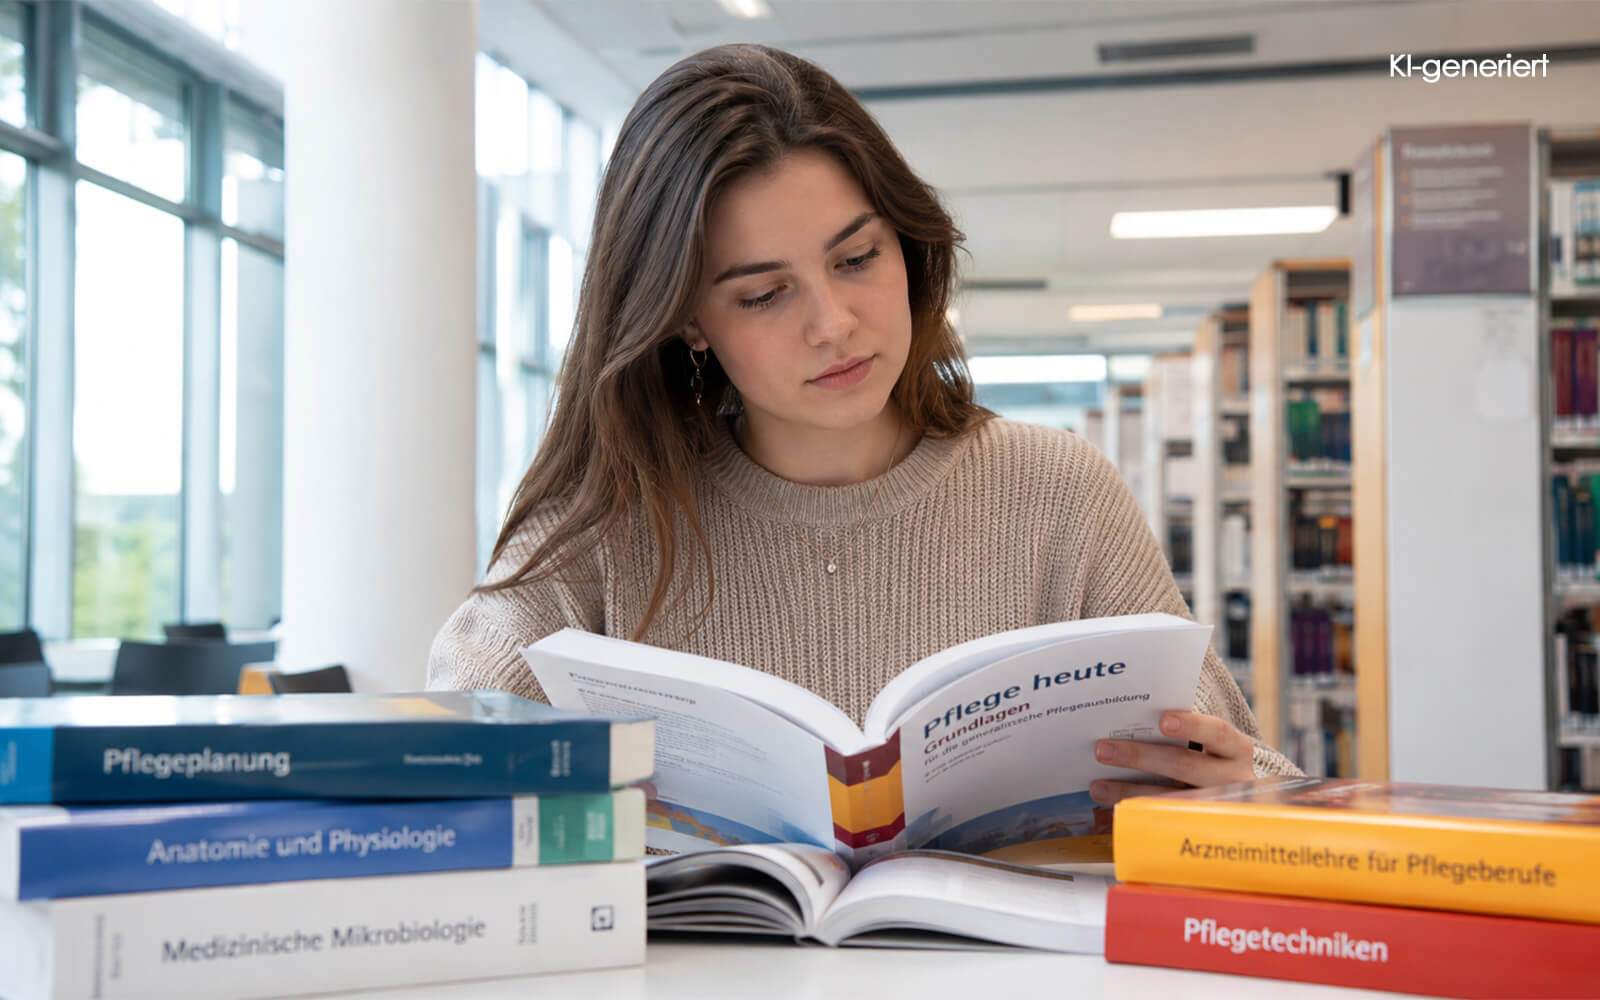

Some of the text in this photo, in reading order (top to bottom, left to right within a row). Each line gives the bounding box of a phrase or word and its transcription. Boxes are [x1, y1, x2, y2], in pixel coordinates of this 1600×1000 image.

[923, 660, 1126, 739] Pflege heute
[1046, 692, 1151, 716] Pflegeausbildung
[923, 701, 1031, 755] Grundlagen
[103, 748, 291, 778] Pflegeplanung
[147, 824, 456, 865] Anatomie und Physiologie
[1179, 837, 1557, 888] Arzneimittellehre für Pflegeberufe
[162, 928, 324, 964] Medizinische
[330, 916, 487, 952] Mikrobiologie
[1183, 917, 1389, 963] Pflegetechniken
